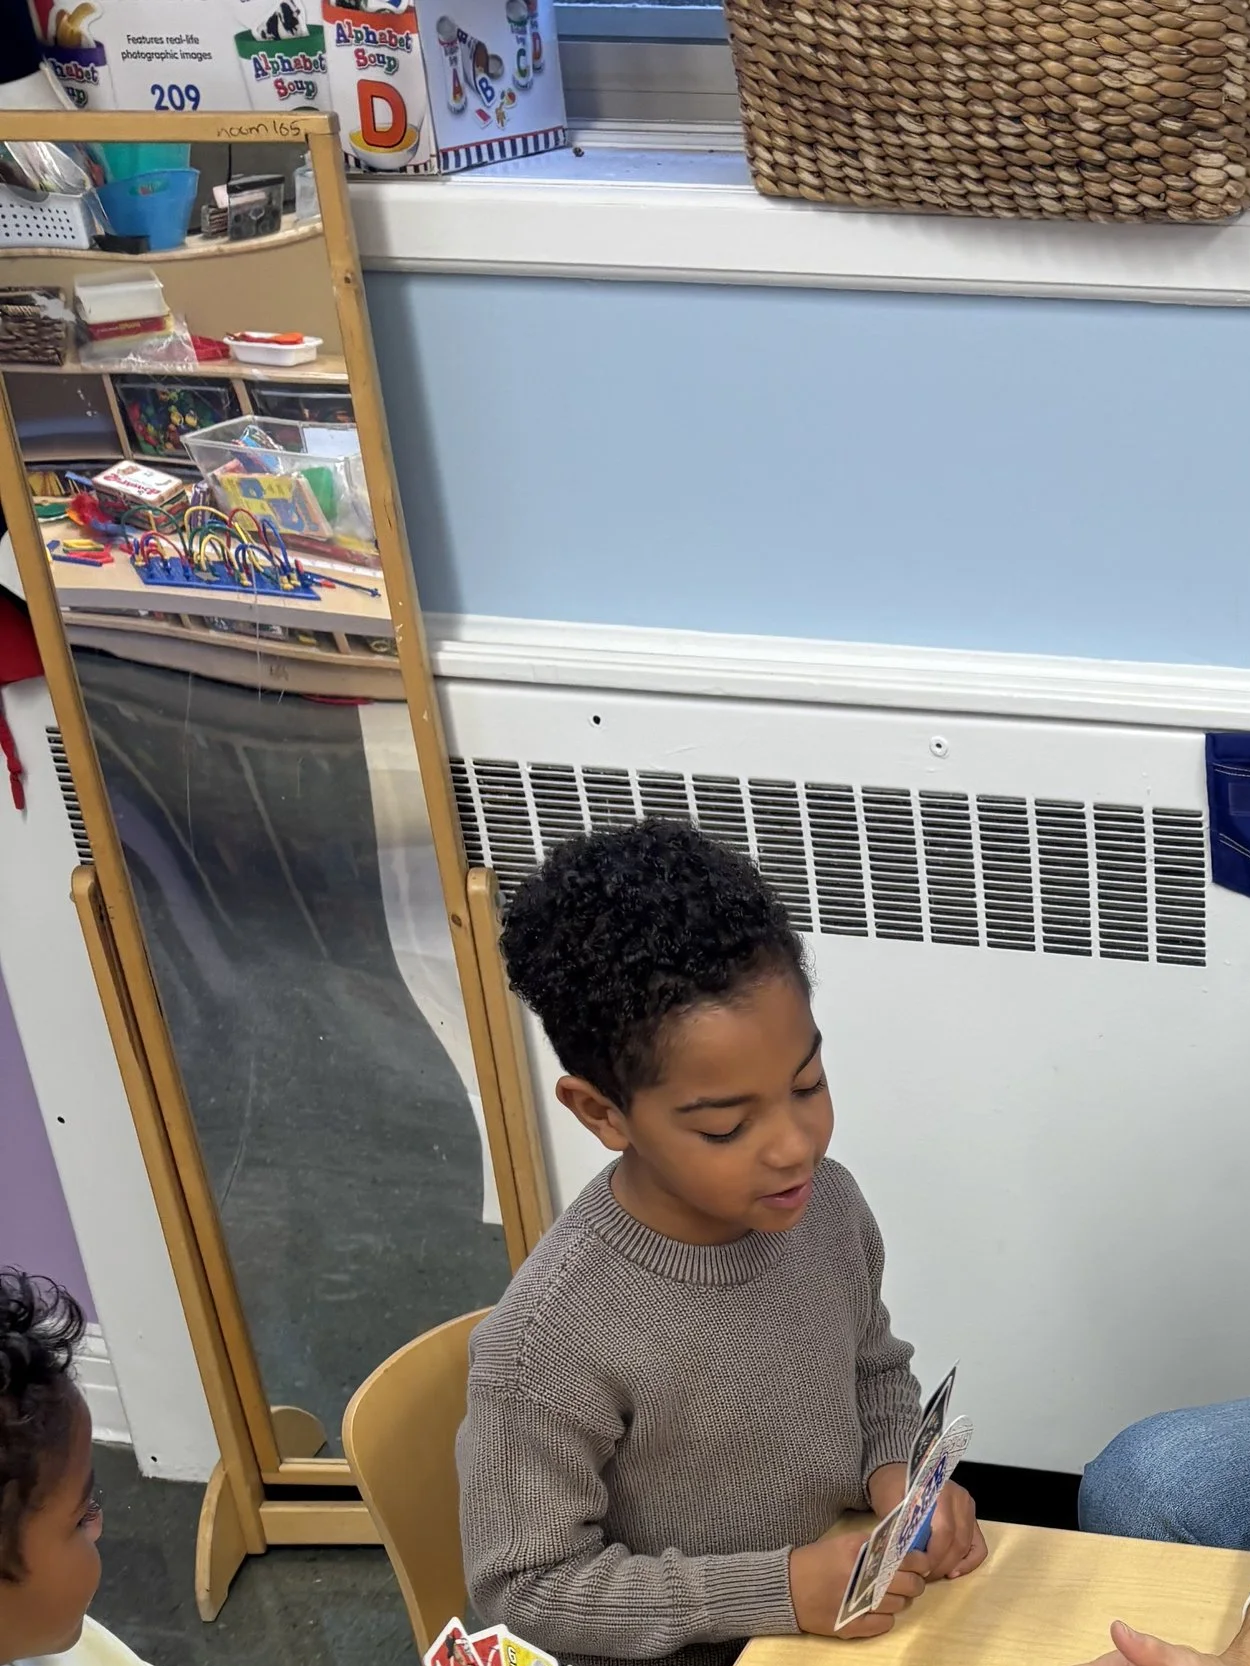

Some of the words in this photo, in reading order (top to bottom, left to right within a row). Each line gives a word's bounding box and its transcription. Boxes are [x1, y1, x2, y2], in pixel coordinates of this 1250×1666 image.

[126, 34, 164, 44] Features
[166, 34, 199, 45] real-life
[336, 21, 412, 51] Alphabet
[121, 50, 179, 61] photographic
[180, 50, 212, 62] images
[252, 52, 326, 79] Alphabet
[354, 48, 399, 74] Soup
[53, 60, 99, 83] habet
[151, 84, 200, 111] 209
[274, 78, 317, 98] Soup
[479, 77, 495, 103] B
[357, 79, 407, 148] D
